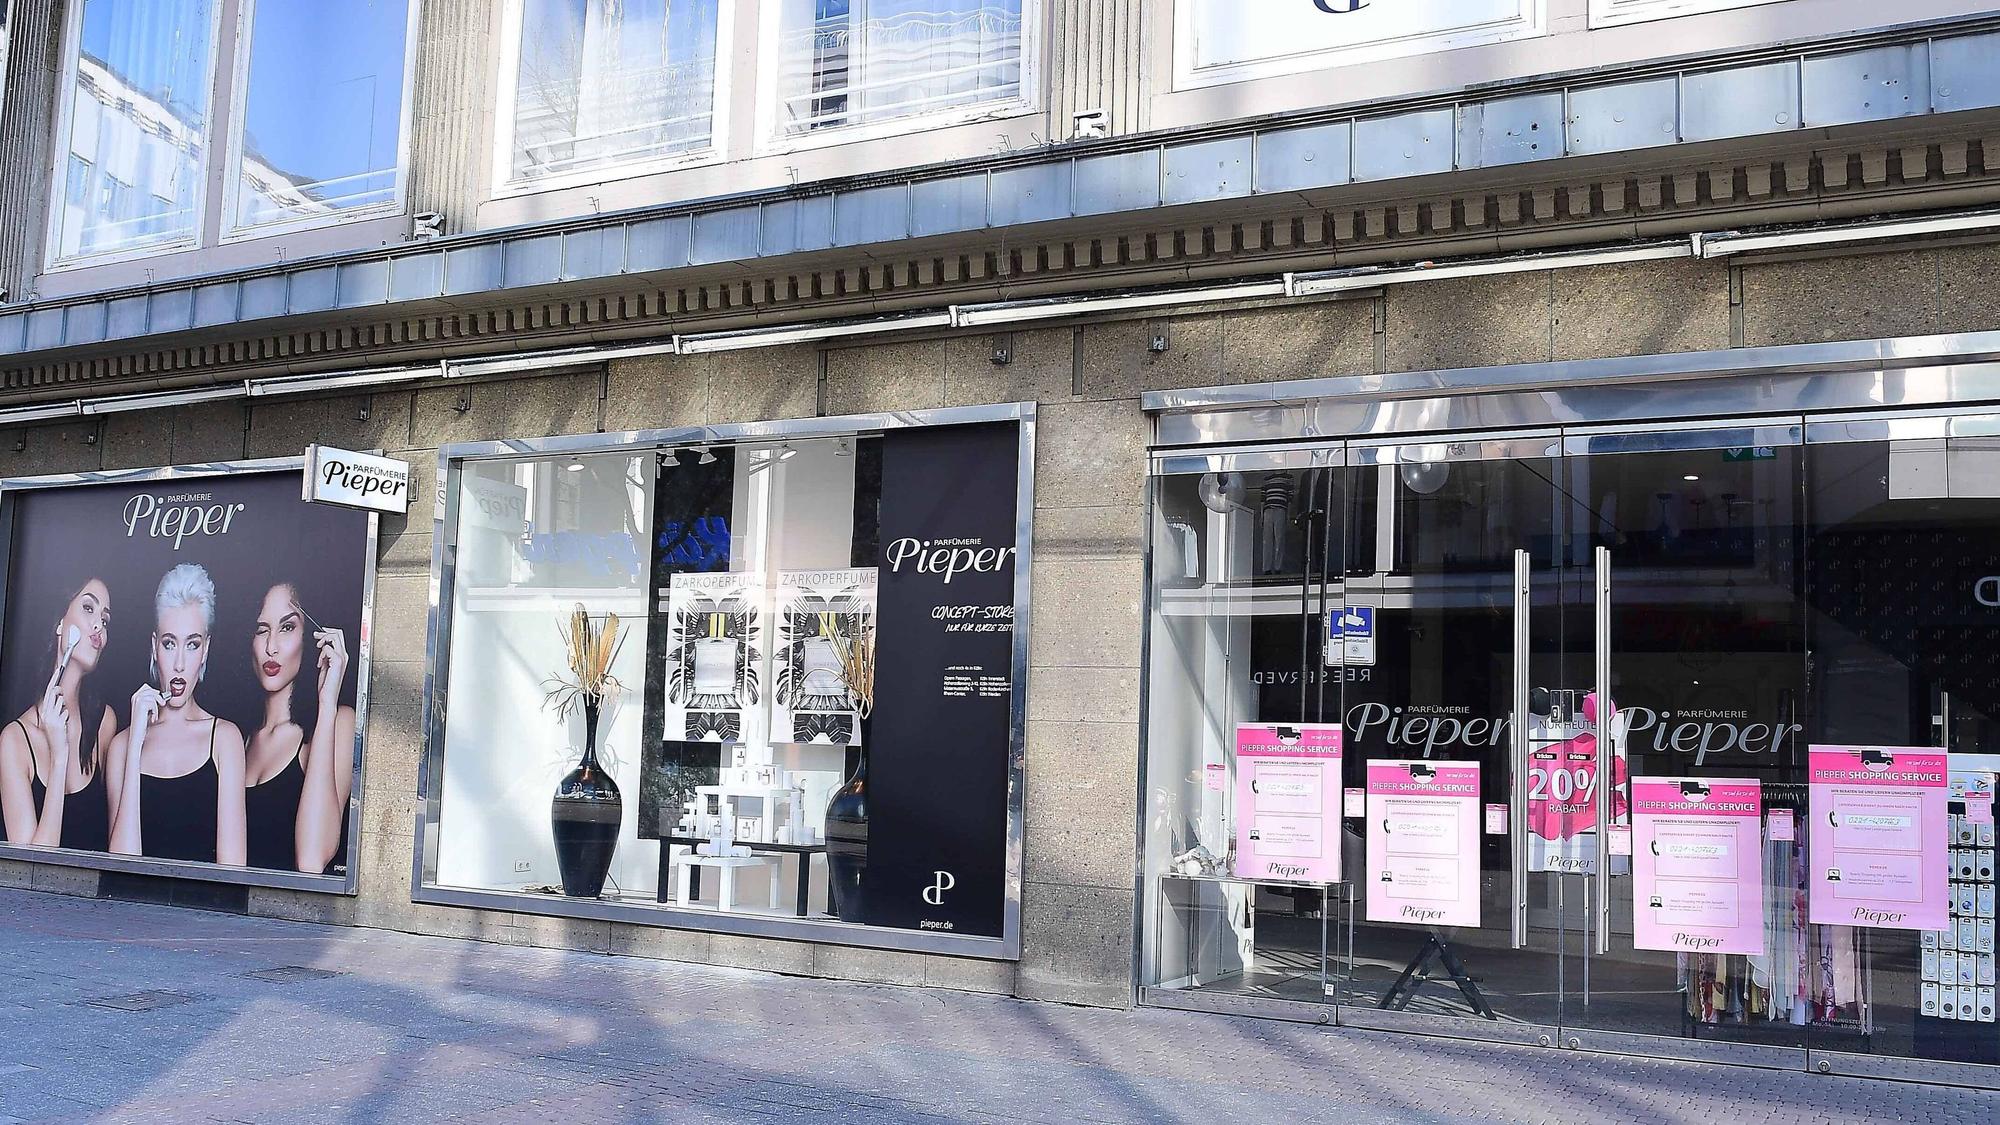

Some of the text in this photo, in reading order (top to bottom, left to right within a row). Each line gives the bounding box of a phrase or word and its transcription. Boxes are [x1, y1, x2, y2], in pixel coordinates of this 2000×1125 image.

[353, 464, 406, 480] PARFÜMERIE
[323, 461, 405, 496] Pieper
[167, 493, 212, 503] PARFÜMERIE
[123, 494, 245, 550] Pieper
[933, 538, 982, 546] PARFÜMERIE
[886, 538, 1016, 583] Pieper
[782, 573, 876, 586] ZARKOPERFUME
[945, 624, 959, 632] NUR
[961, 623, 973, 631] FÜR
[1408, 704, 1470, 714] PARFÜMERIE
[1677, 708, 1747, 719] PARFÜMERIE
[1346, 702, 1514, 758] Pieper
[1565, 720, 1598, 730] HEUTE
[1608, 706, 1803, 766] Pieper
[1241, 744, 1338, 754] PIEPER SHOPPING SERVICE
[1815, 770, 1941, 782] PIEPER SHOPPING SERVICE
[1372, 782, 1475, 793] PIEPER SHOPPING SERVICE
[1549, 803, 1590, 814] RABATT
[1638, 800, 1755, 812] PIEPER SHOPPING SERVICE
[1546, 855, 1594, 871] Pieper
[1266, 862, 1310, 878] Pieper
[1400, 904, 1446, 921] Pieper
[1851, 907, 1907, 925] Pieper
[920, 918, 954, 930] pieper.de
[1672, 932, 1724, 950] Pieper
